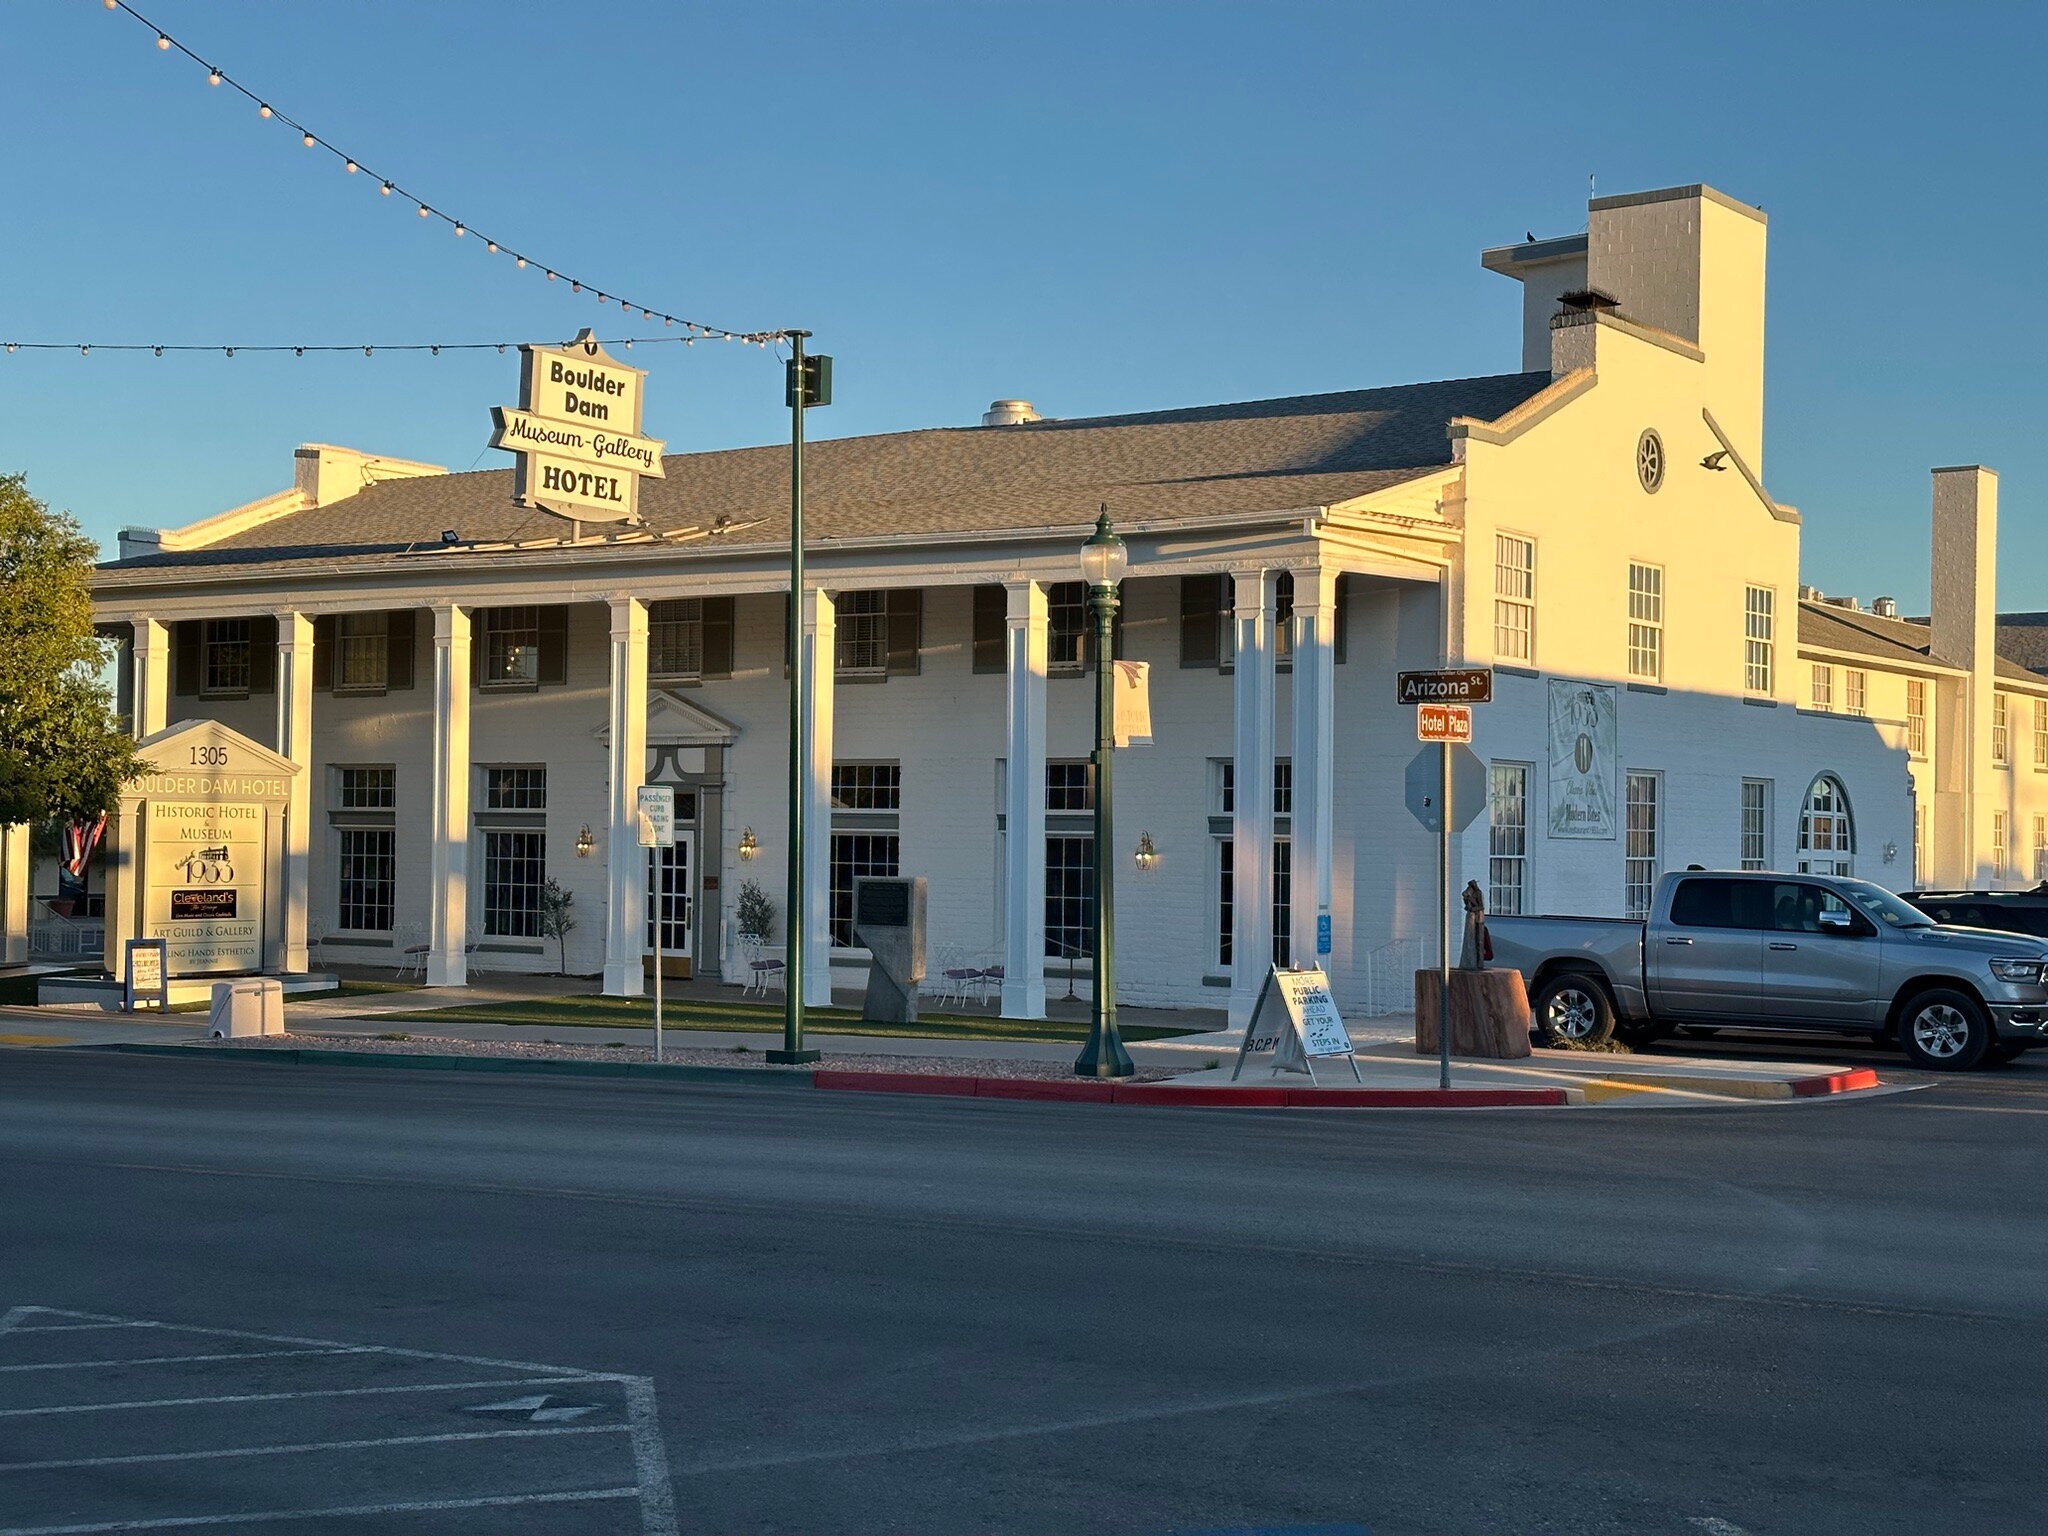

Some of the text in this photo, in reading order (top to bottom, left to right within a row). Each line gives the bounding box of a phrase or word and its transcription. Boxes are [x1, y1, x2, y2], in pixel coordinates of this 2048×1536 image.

[551, 361, 625, 397] Boulder
[565, 391, 608, 420] Dam
[543, 466, 622, 502] HOTEL
[1405, 676, 1483, 696] Arizona St.
[1421, 714, 1468, 733] Hotel Plaza
[190, 746, 228, 766] 1305
[201, 778, 237, 795] DAM
[241, 779, 288, 796] HOTEL
[640, 794, 671, 802] PASSENGER
[156, 805, 257, 819] HISTORIC HOTEL
[1566, 803, 1586, 821] Modern
[180, 828, 232, 840] MUSEUM
[184, 859, 234, 883] 1933
[173, 892, 234, 903] Cleveland's
[153, 926, 254, 938] ART GUILD & GALLERY
[167, 950, 185, 958] LING
[188, 949, 215, 957] HANDS
[217, 947, 255, 956] ESTHETICS
[1292, 976, 1316, 986] MORE
[1292, 986, 1321, 996] PUBLIC
[1292, 995, 1329, 1006] PARKING
[1303, 1005, 1326, 1015] AHEAD
[1302, 1016, 1334, 1026] GET YOUR
[1312, 1037, 1340, 1047] STEPS IN
